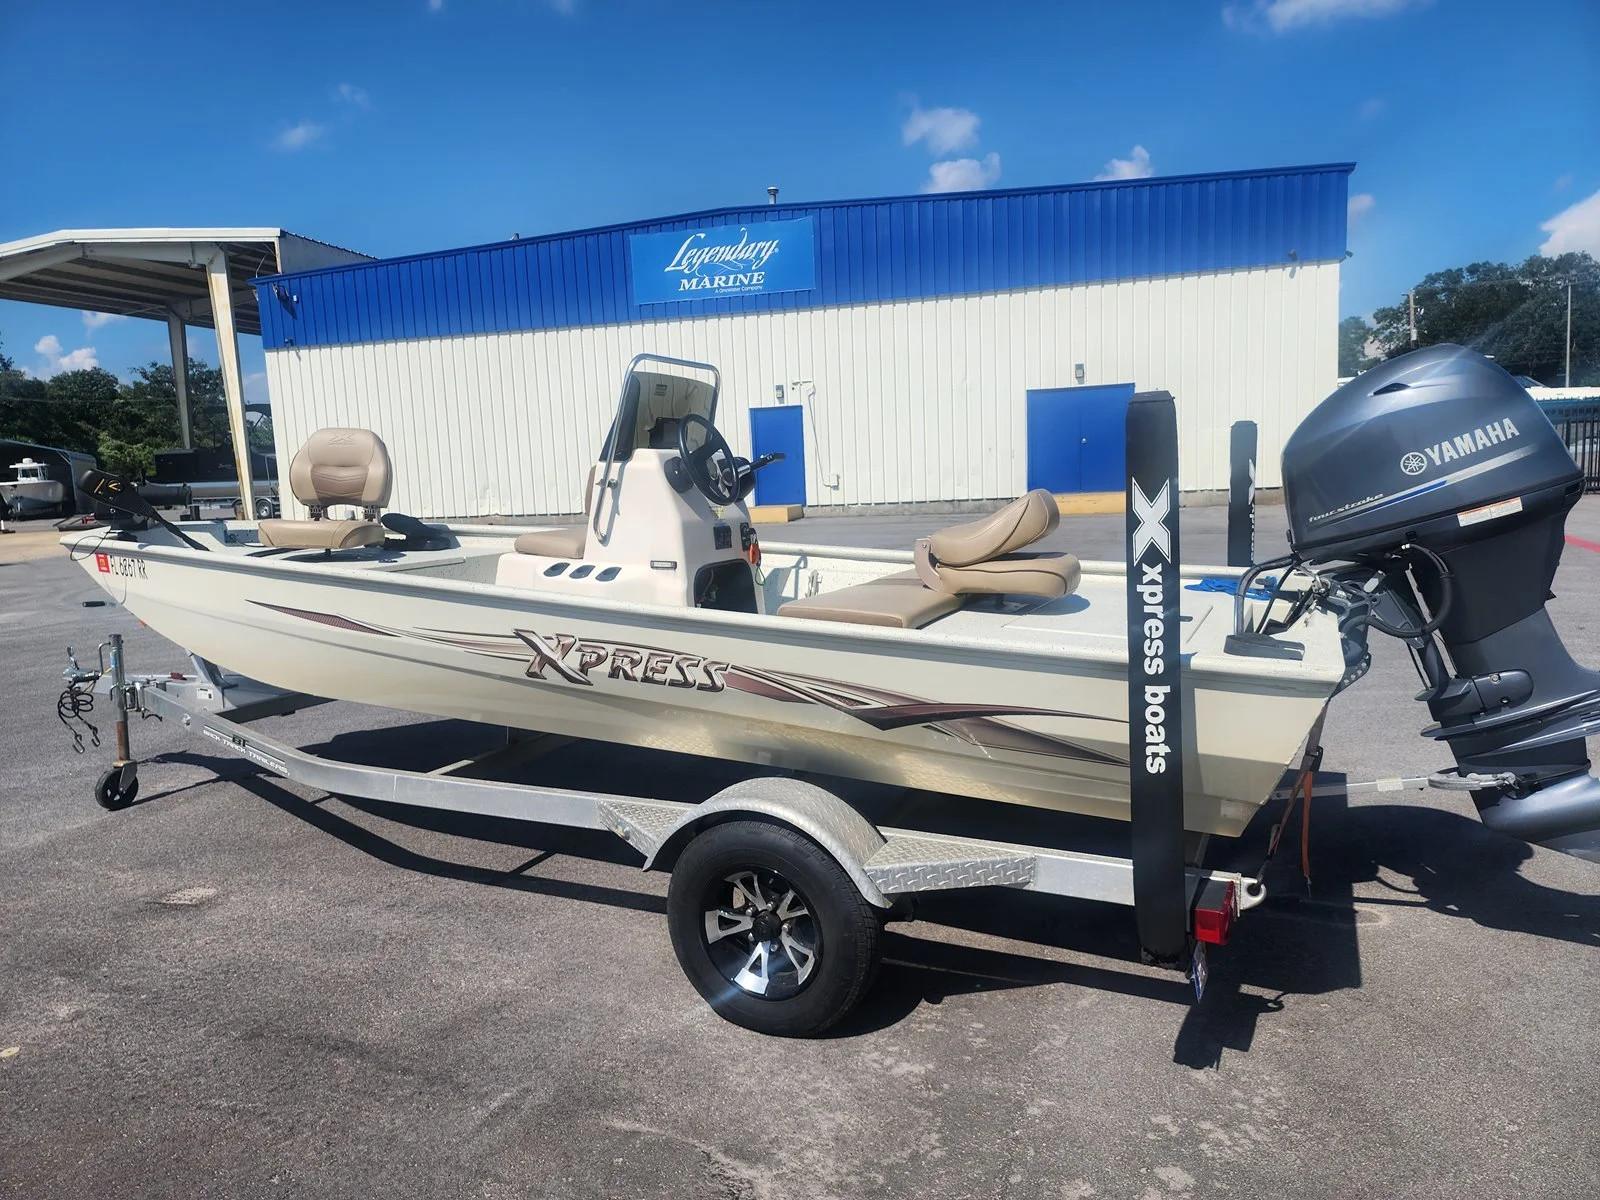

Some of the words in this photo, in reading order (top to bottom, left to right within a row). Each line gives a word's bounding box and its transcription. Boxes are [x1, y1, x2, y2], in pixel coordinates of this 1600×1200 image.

[664, 227, 780, 277] Legendary
[678, 271, 766, 292] MARINE
[1424, 417, 1520, 466] YAMAHA
[1136, 563, 1165, 676] xpress
[1144, 685, 1171, 775] boats
